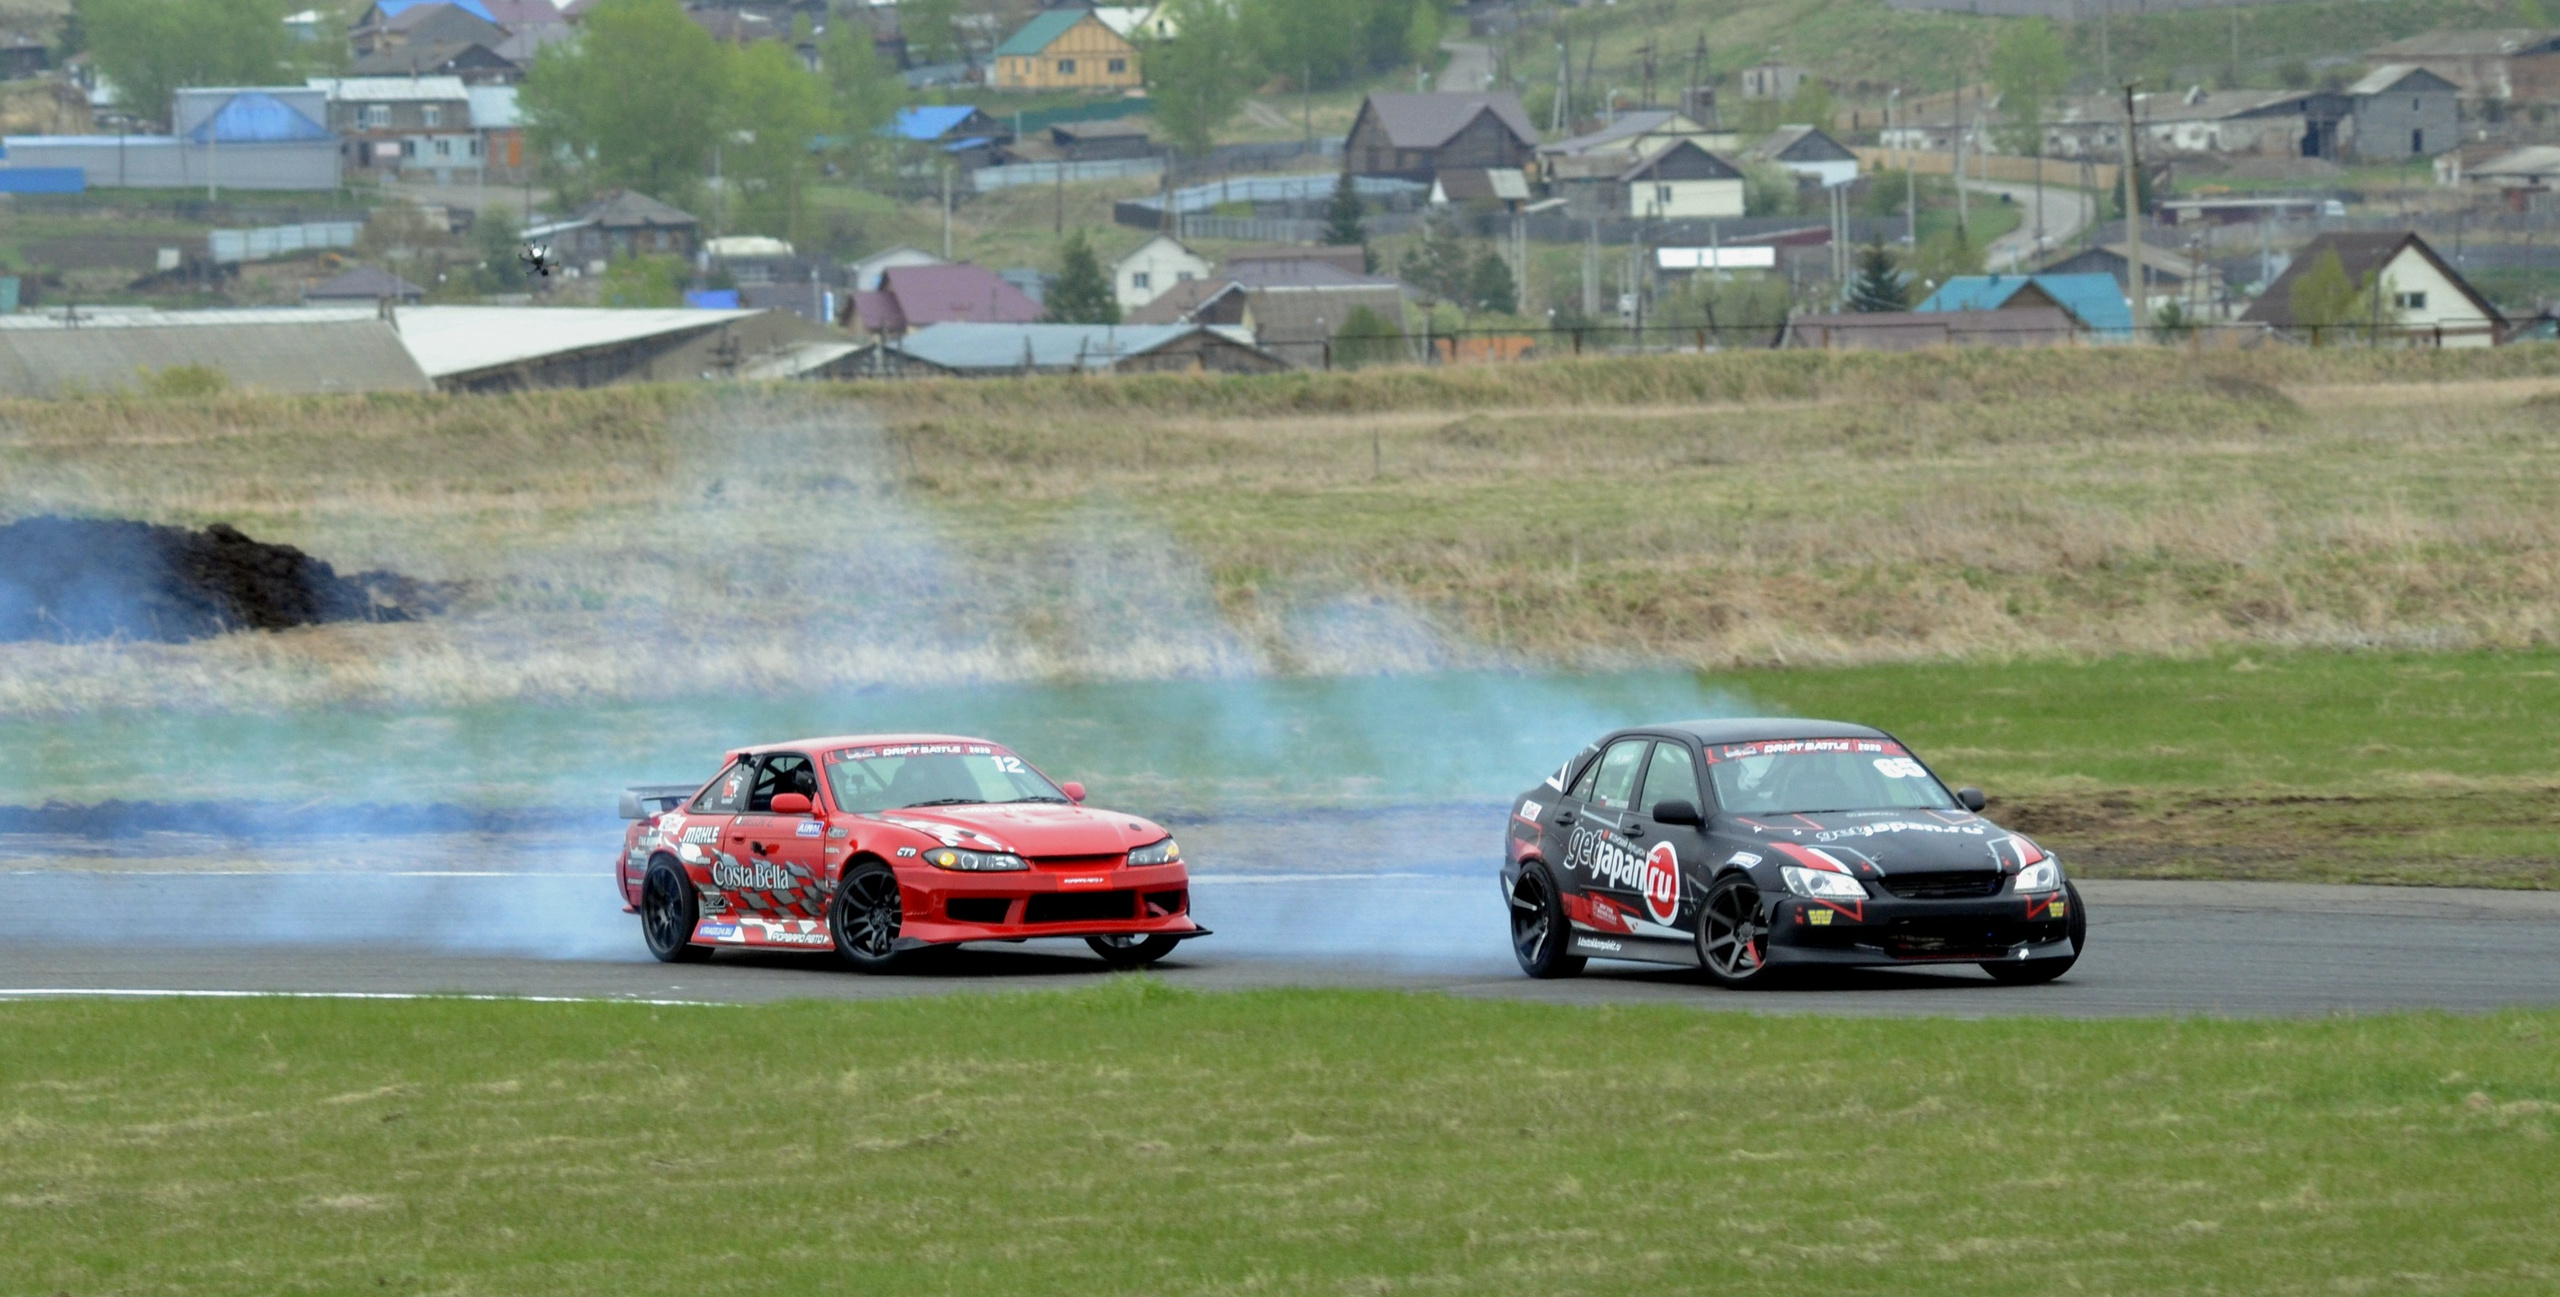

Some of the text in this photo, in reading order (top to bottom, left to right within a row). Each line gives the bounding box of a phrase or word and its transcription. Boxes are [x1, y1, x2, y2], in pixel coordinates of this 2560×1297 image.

[883, 746, 919, 757] DRIFT
[921, 745, 961, 754] BATTLE
[1764, 742, 1804, 754] DRIFT
[1805, 742, 1849, 751] BATTLE
[991, 756, 1026, 774] 12
[682, 827, 720, 844] MAHLE
[713, 860, 790, 890] Costa Bella
